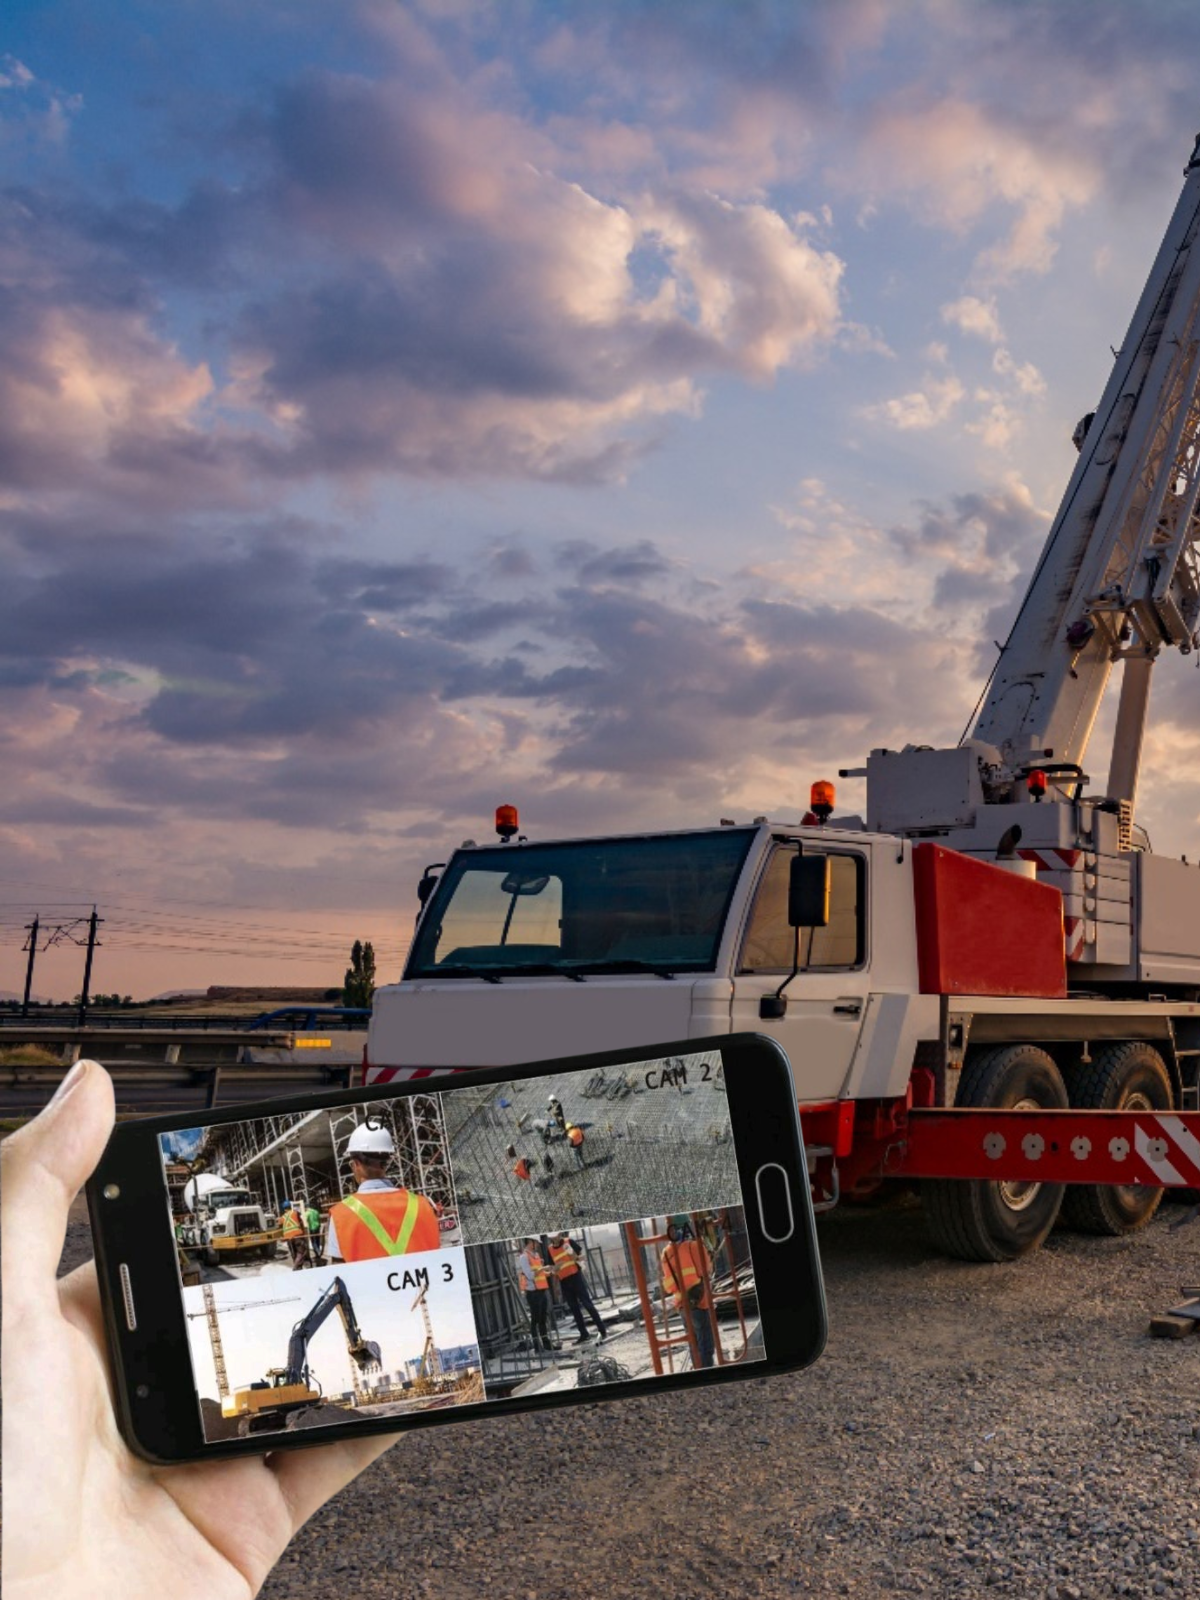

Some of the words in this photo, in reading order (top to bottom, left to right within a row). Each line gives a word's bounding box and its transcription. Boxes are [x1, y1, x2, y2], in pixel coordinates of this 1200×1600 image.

[645, 1065, 688, 1090] CAM
[699, 1063, 713, 1082] 2
[387, 1267, 430, 1291] CAM
[441, 1263, 454, 1282] 3
